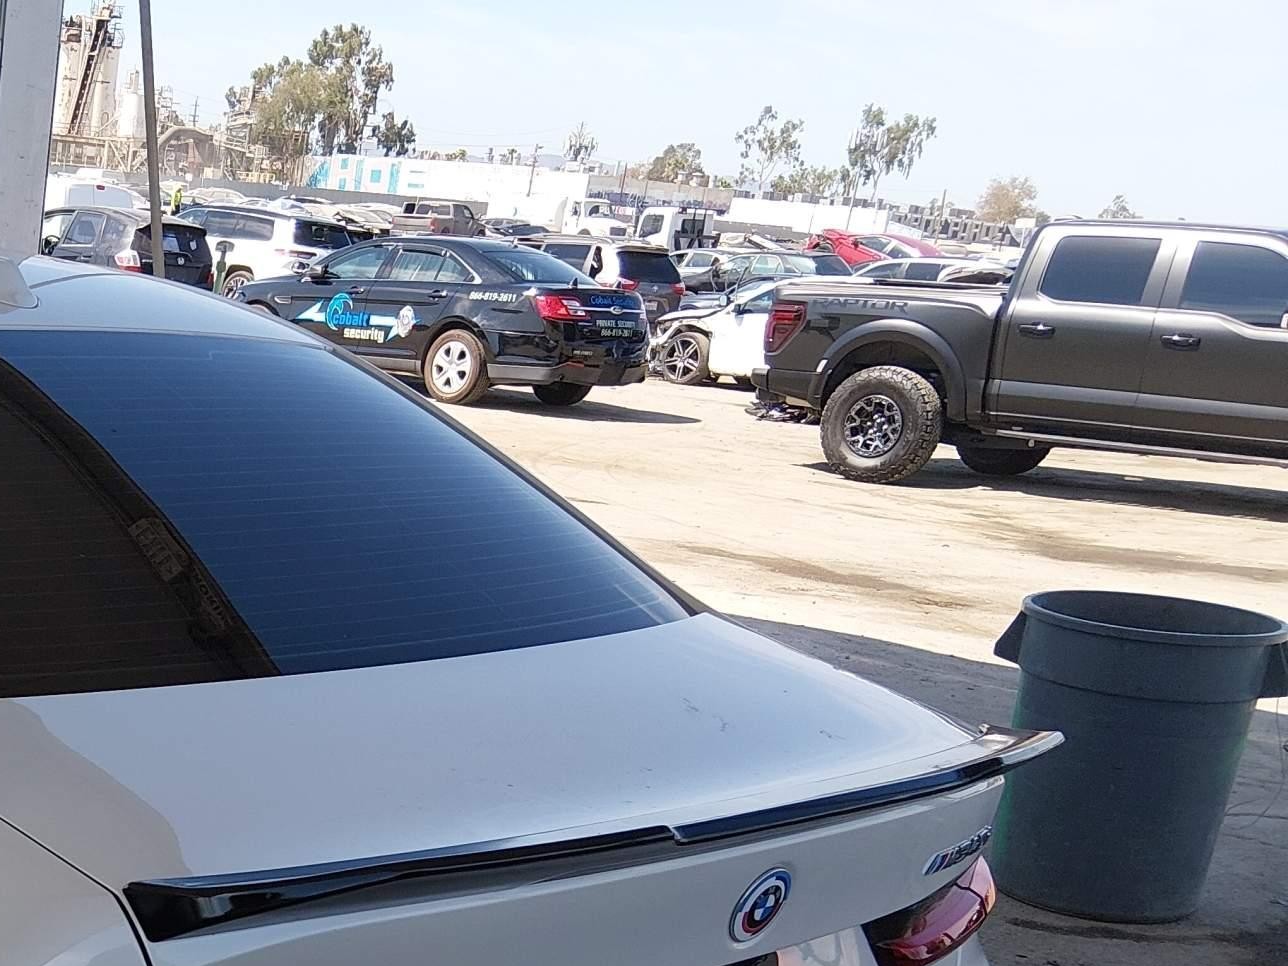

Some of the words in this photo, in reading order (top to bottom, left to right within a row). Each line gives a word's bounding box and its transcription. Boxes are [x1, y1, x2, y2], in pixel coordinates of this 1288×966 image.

[811, 298, 909, 316] RAPTOR
[332, 310, 370, 327] cobalt
[343, 327, 385, 344] security
